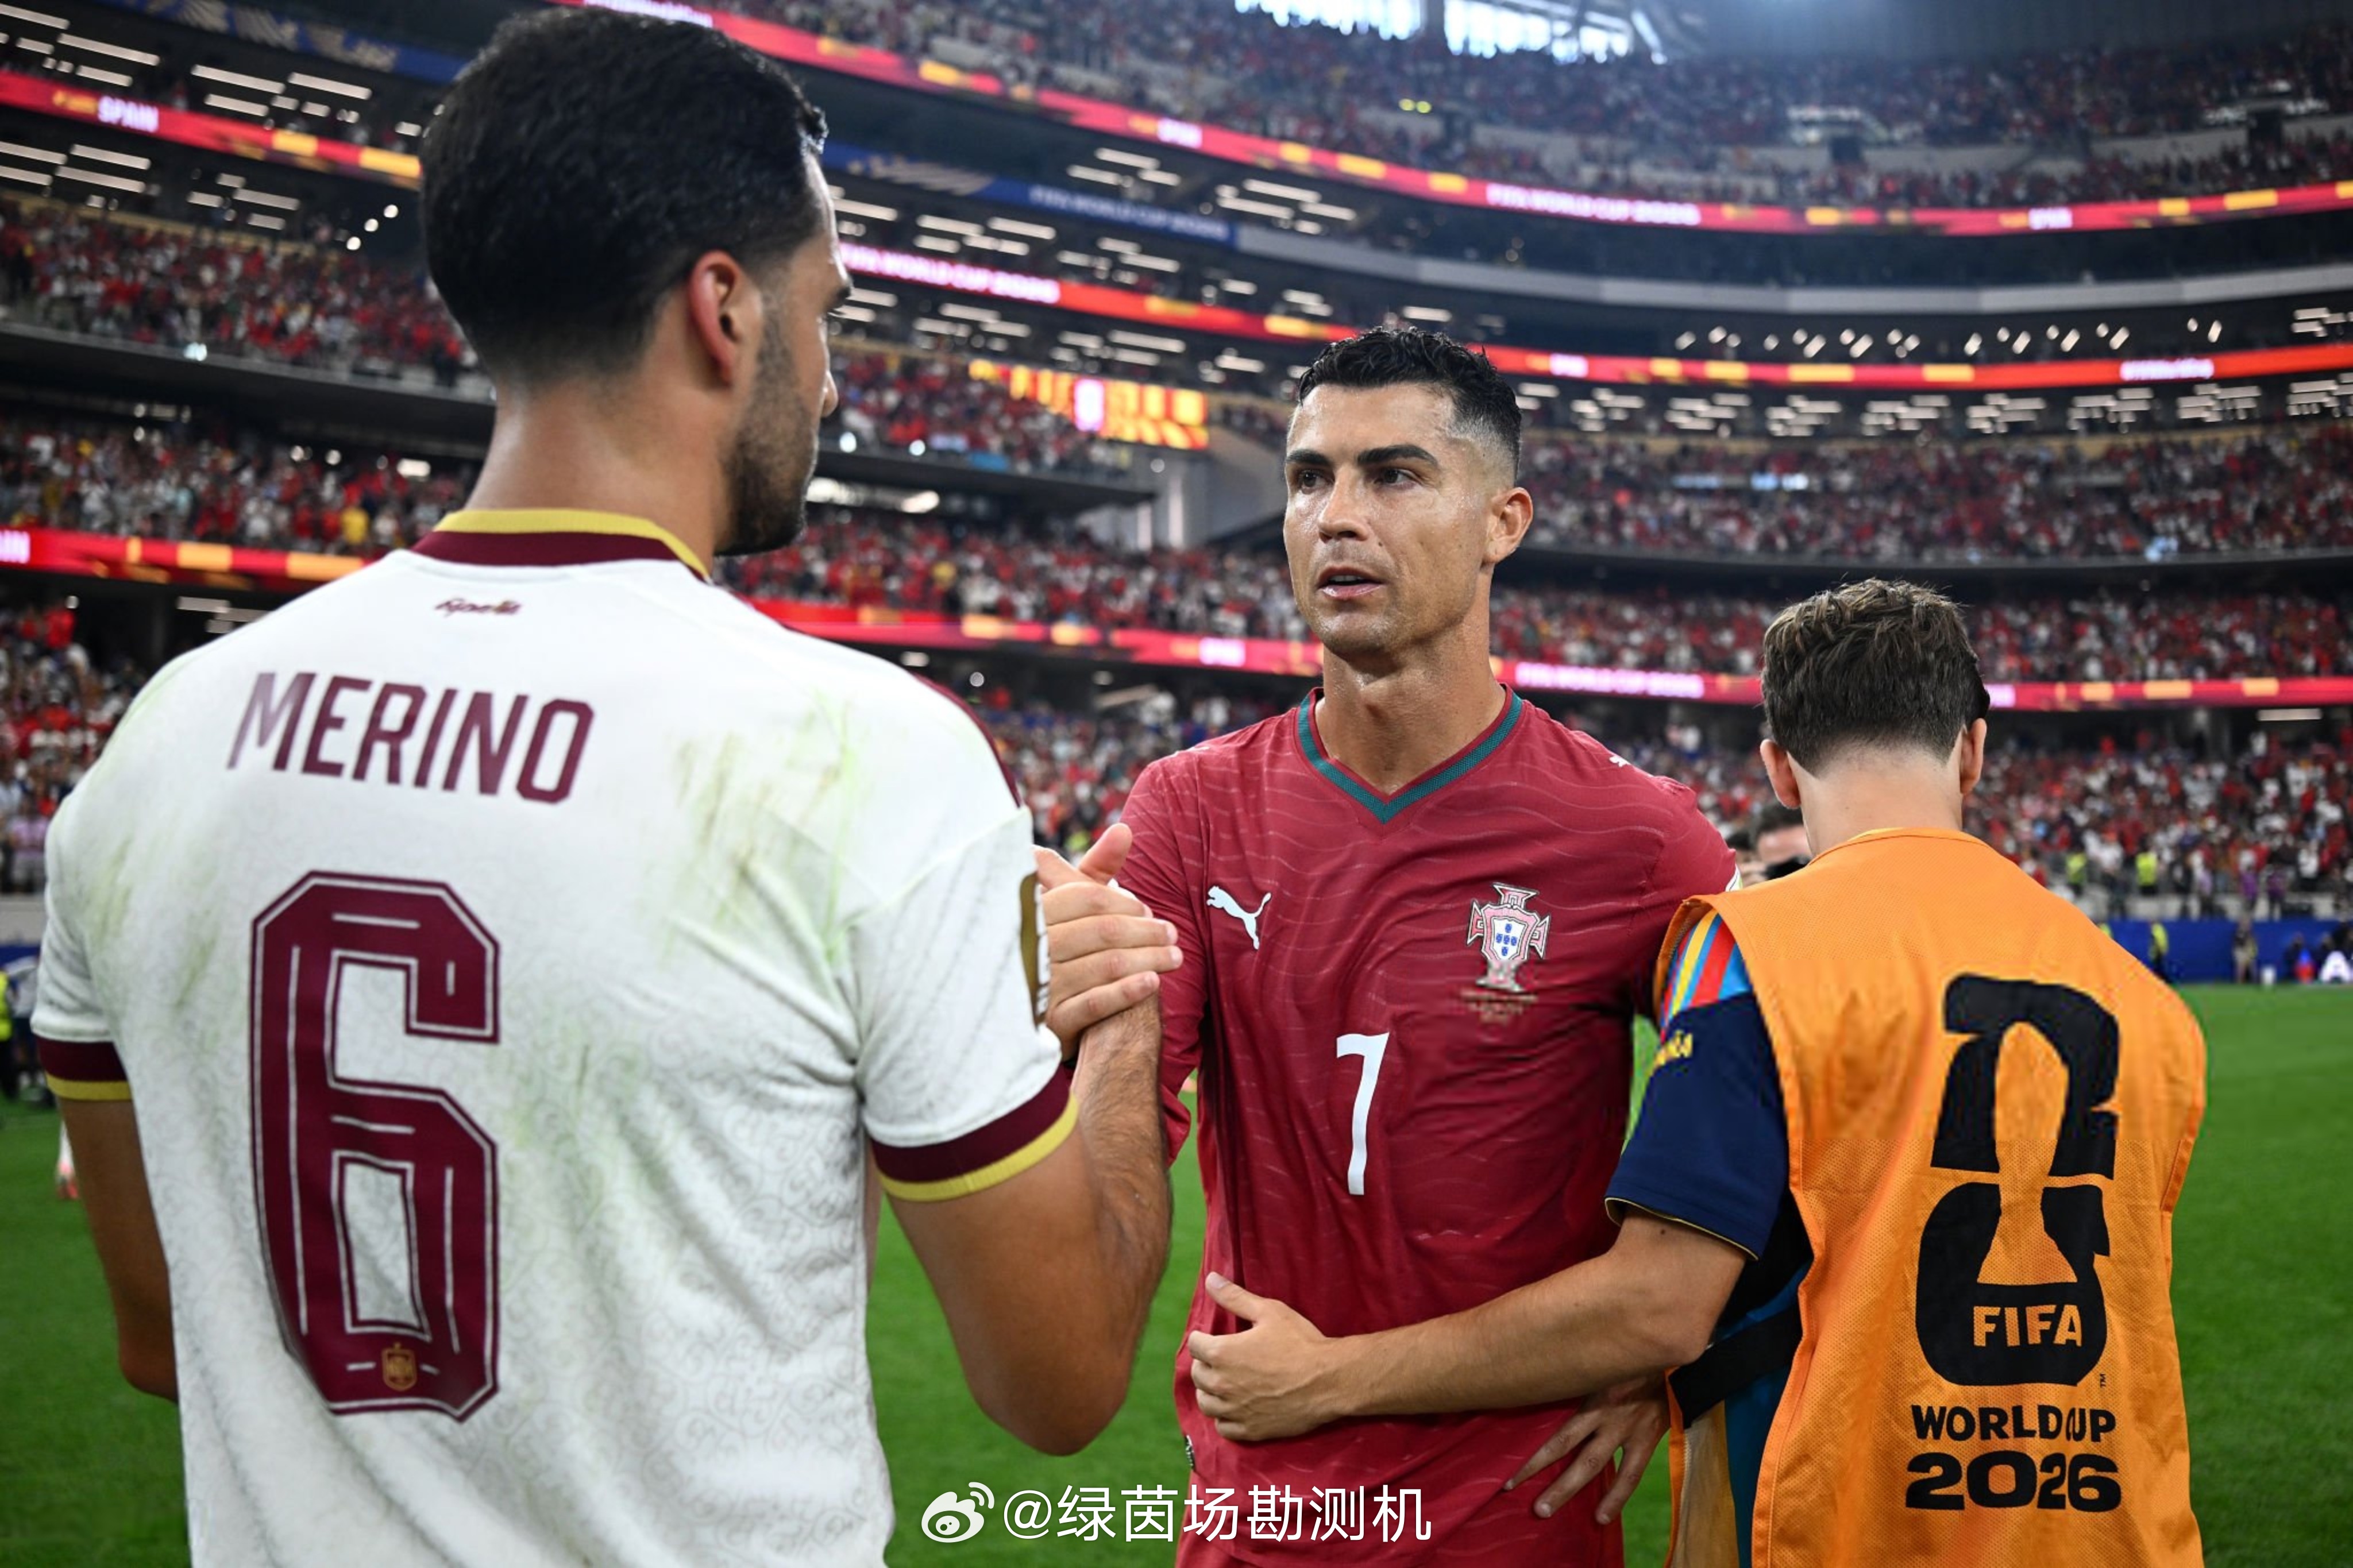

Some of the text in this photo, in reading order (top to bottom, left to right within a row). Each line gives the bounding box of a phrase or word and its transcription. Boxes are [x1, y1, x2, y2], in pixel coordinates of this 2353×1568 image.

[98, 95, 159, 133] SPAIN
[226, 672, 595, 805] MERINO
[1336, 1032, 1389, 1195] 7
[248, 870, 500, 1423] 6
[1973, 1304, 2082, 1347] FIFA
[1911, 1404, 2062, 1441] WORLD
[1905, 1450, 2121, 1513] 2026
